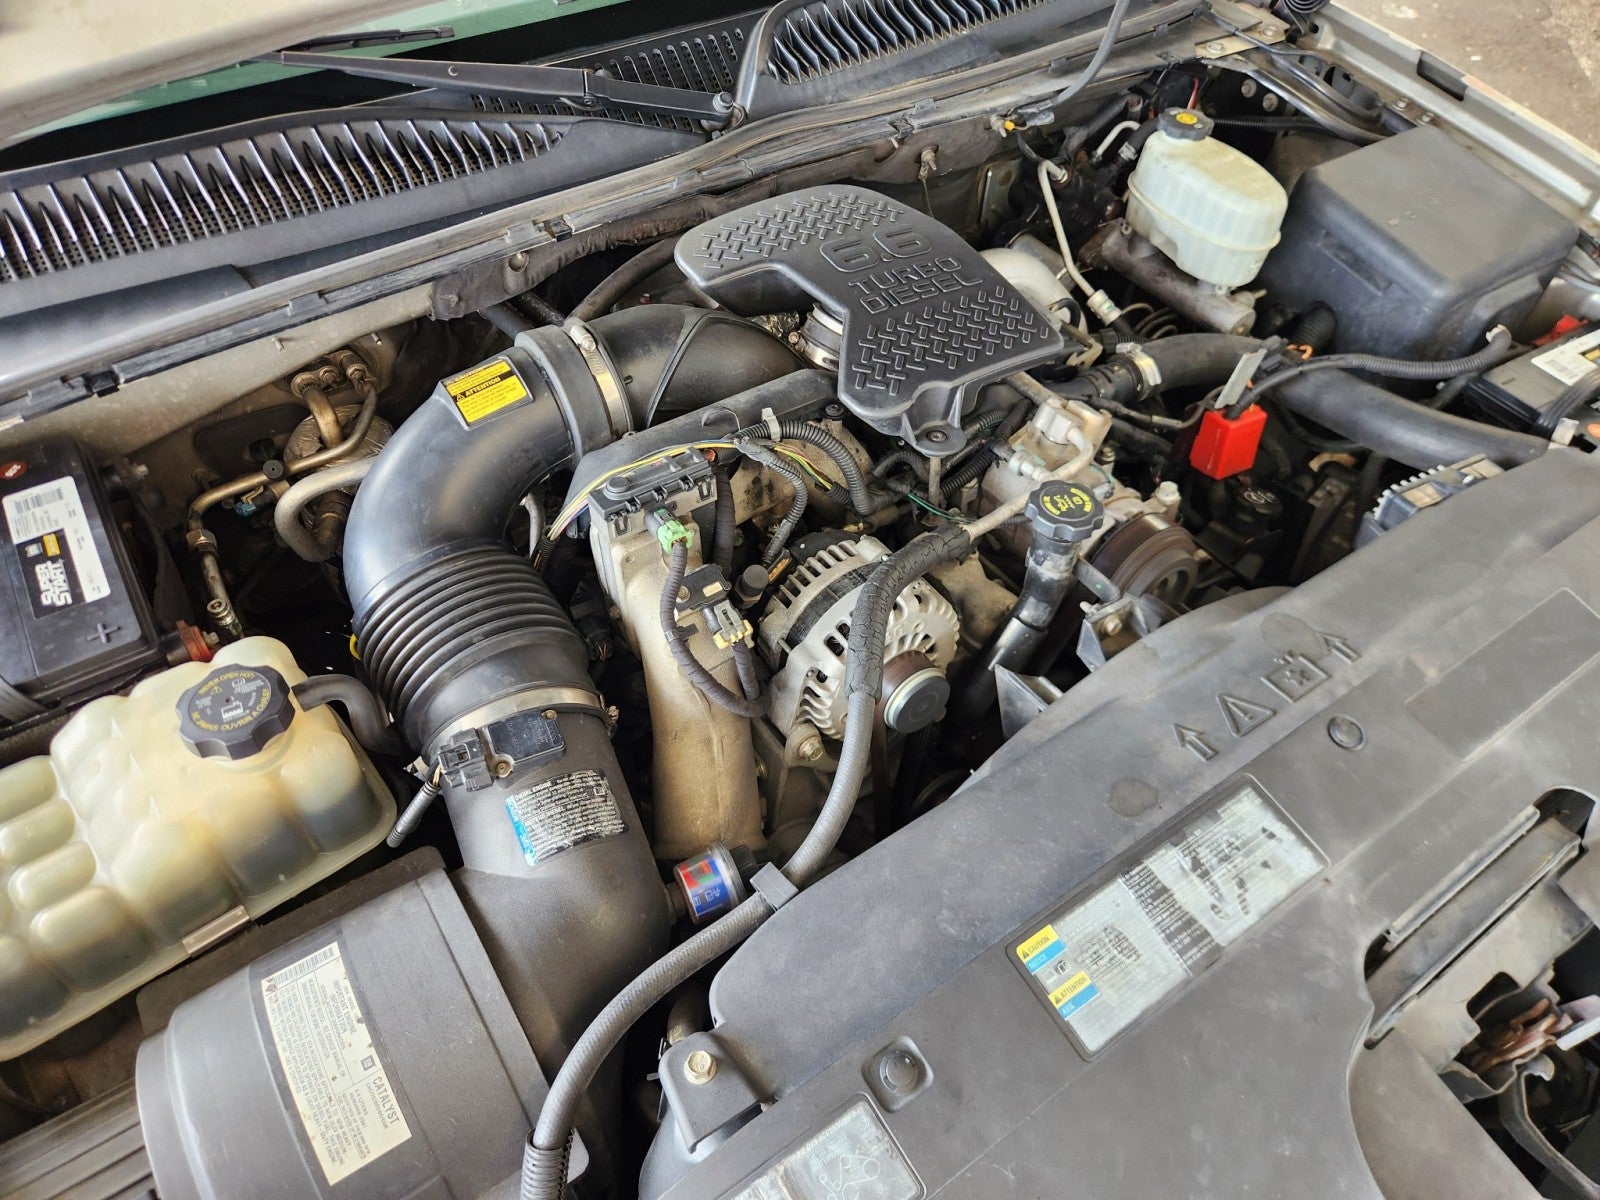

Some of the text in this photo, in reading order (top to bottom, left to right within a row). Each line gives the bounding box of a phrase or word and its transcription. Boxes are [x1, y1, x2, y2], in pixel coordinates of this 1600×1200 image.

[820, 224, 932, 273] 6.6
[848, 257, 961, 294] TURBO
[860, 272, 983, 314] DIESEL
[465, 376, 501, 396] ATTENTION
[35, 562, 54, 606] SUPER
[46, 558, 73, 606] START
[1028, 936, 1050, 954] CAUTION
[1060, 976, 1088, 999] ATTENTION
[328, 993, 348, 1033] INFORMATION
[343, 1011, 357, 1034] ENGINE
[371, 1076, 399, 1124] CATALYST
